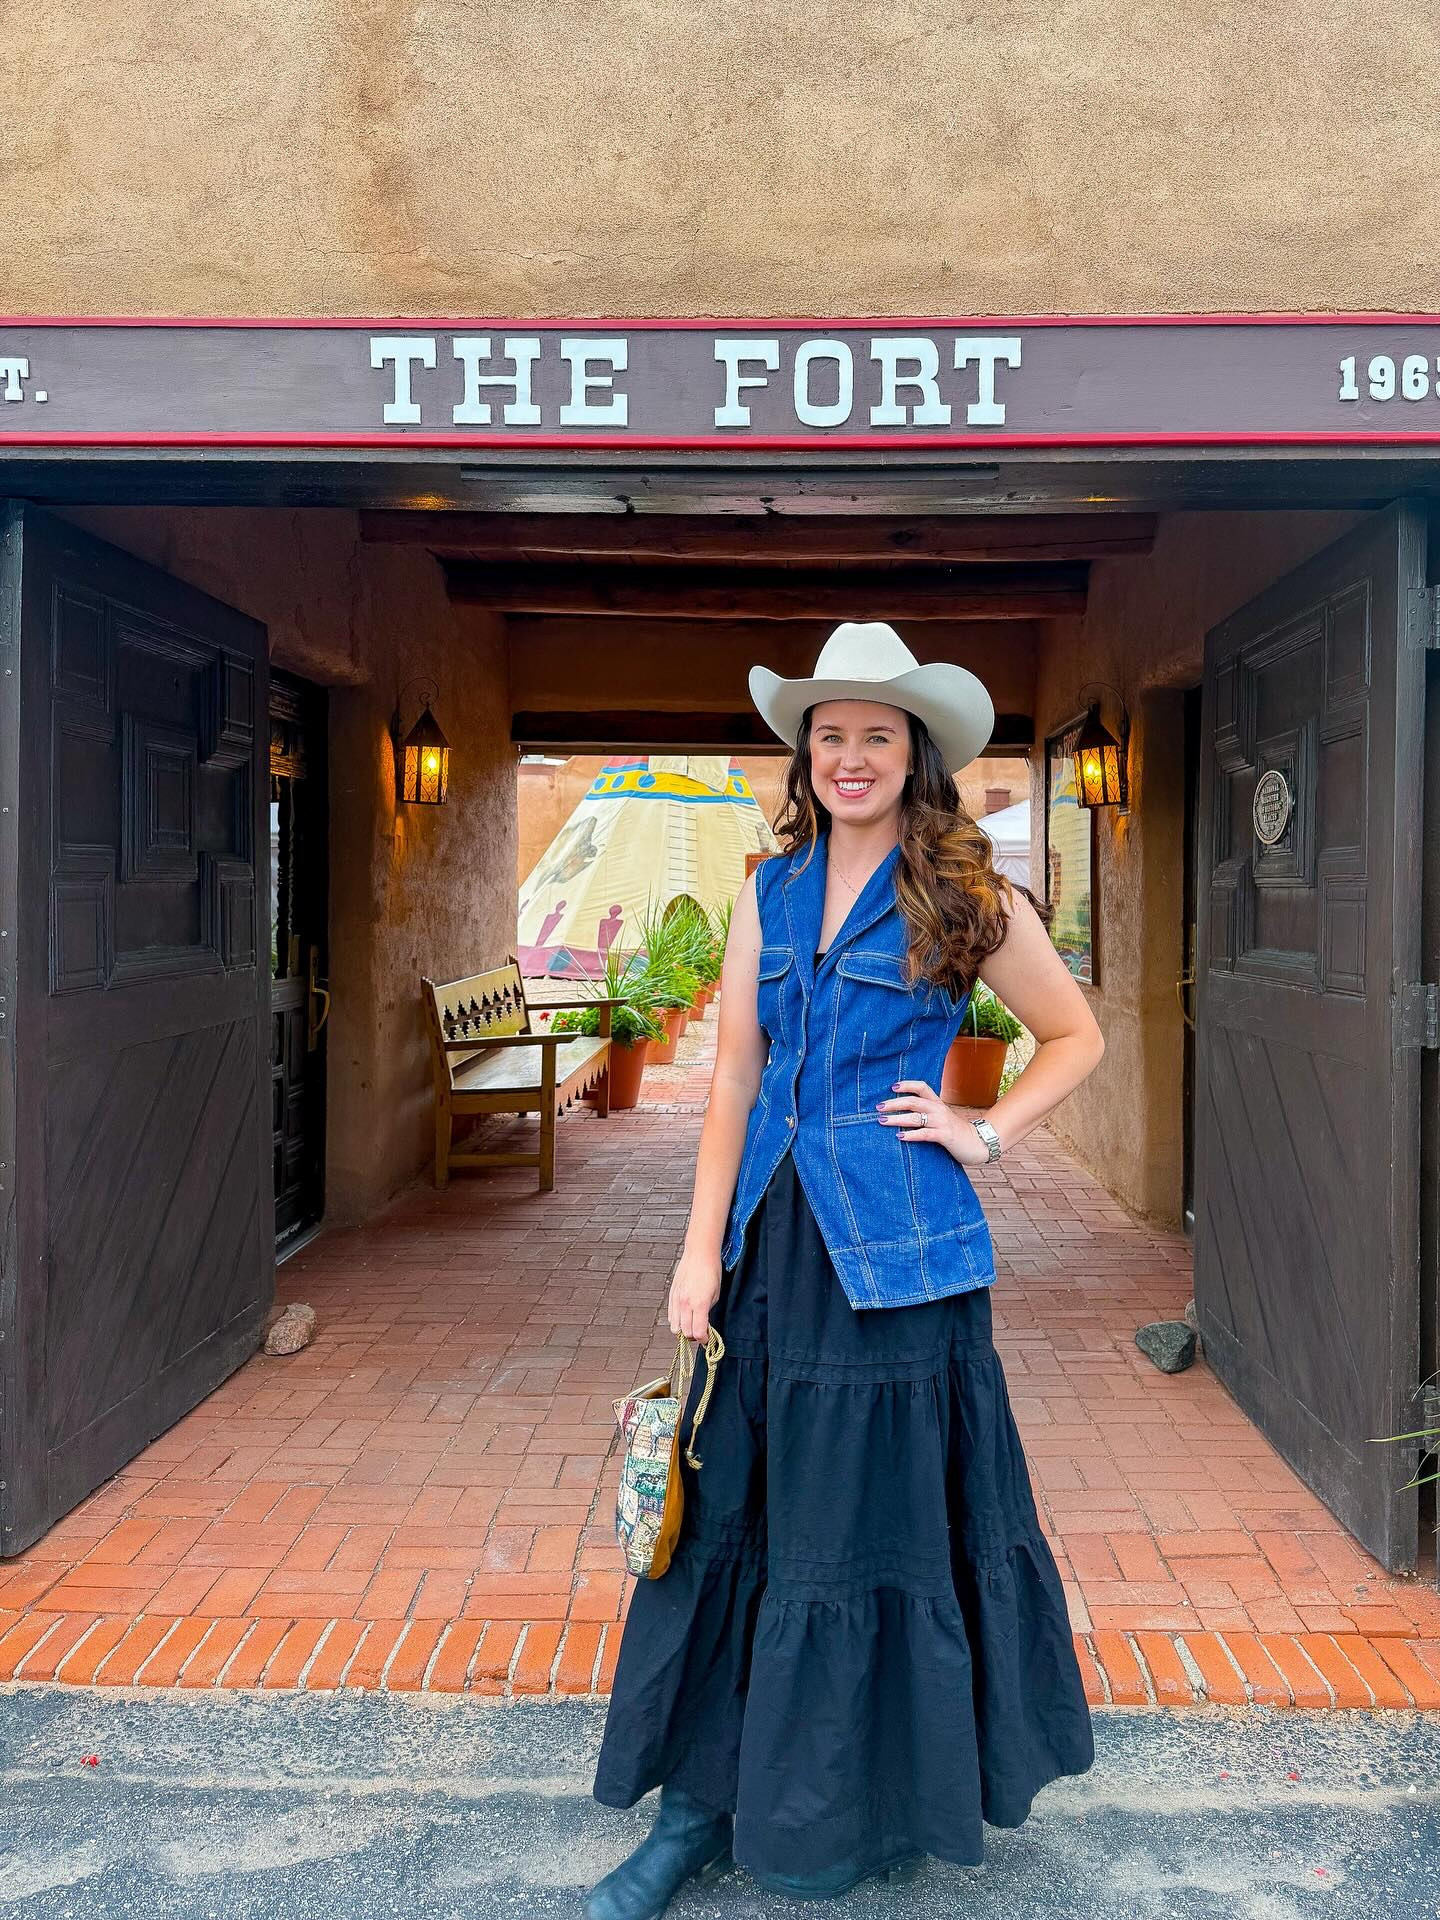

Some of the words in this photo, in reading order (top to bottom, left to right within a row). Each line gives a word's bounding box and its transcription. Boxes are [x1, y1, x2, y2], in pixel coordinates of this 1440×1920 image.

[369, 335, 629, 427] THE
[713, 337, 1022, 428] FORT
[1338, 354, 1440, 401] 196
